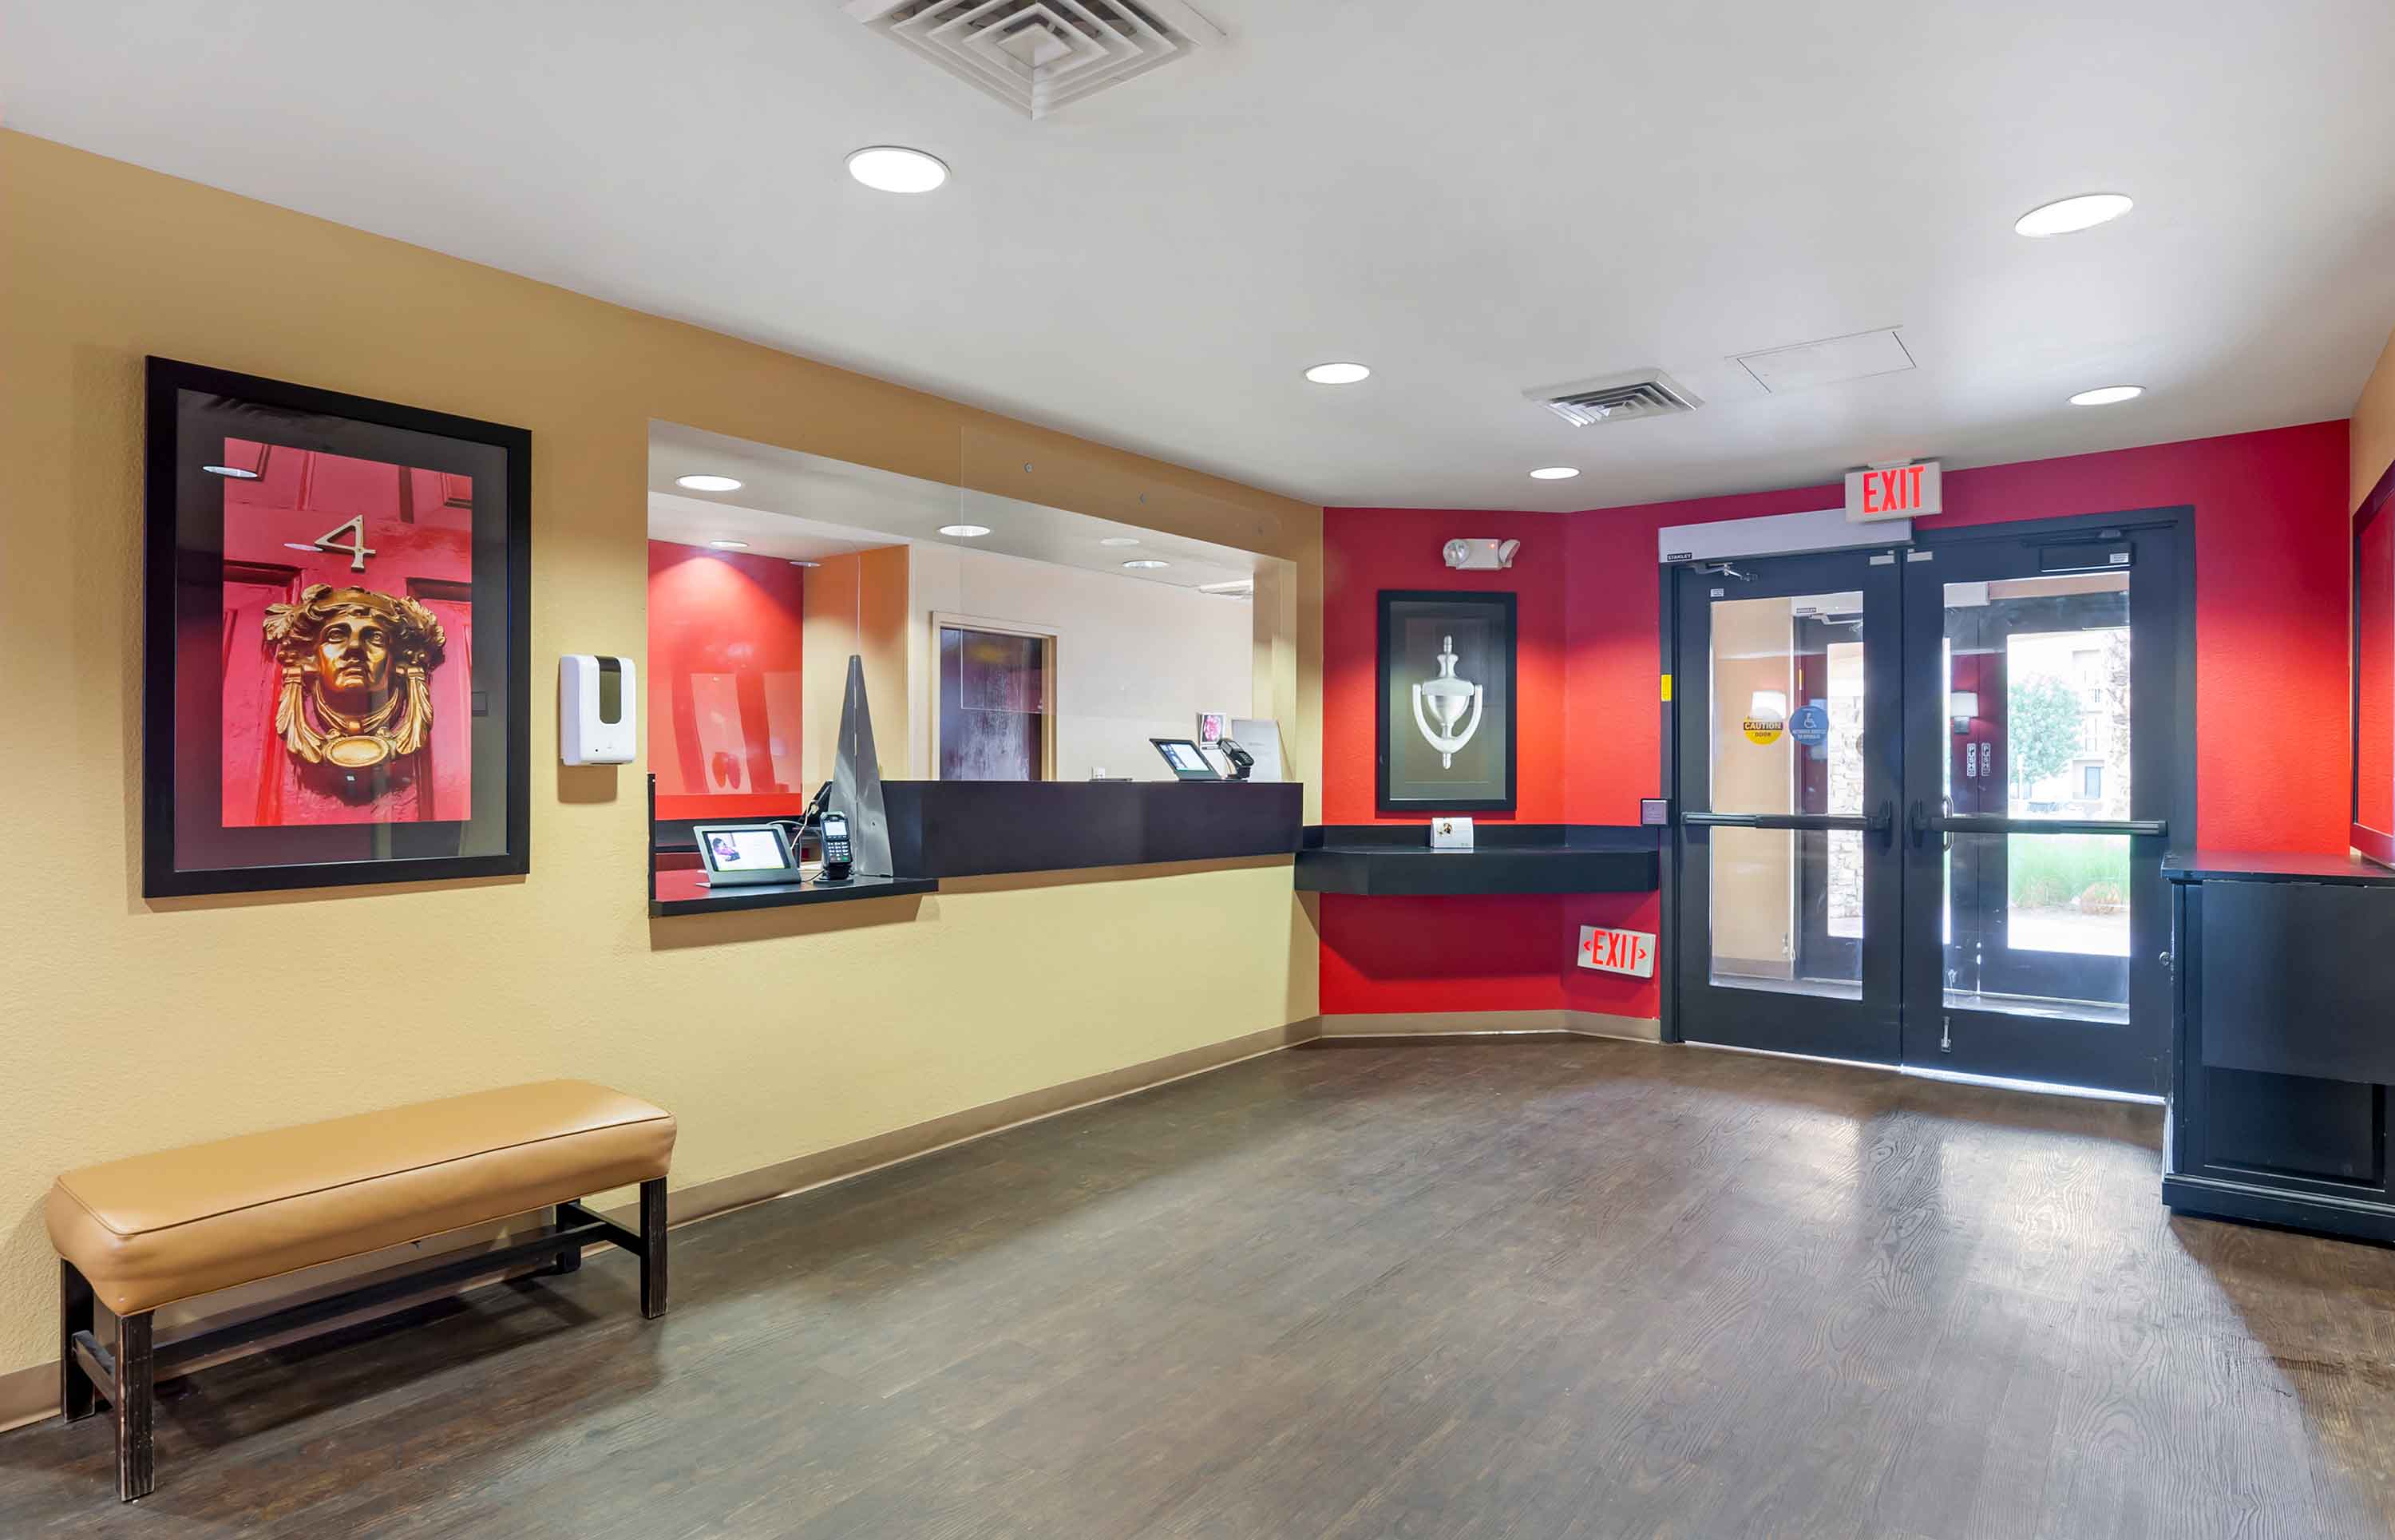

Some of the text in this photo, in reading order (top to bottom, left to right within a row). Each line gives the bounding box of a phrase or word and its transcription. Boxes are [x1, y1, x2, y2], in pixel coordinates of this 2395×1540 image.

[1863, 465, 1925, 513] EXIT
[315, 515, 376, 570] 4
[1592, 929, 1641, 971] EXIT
